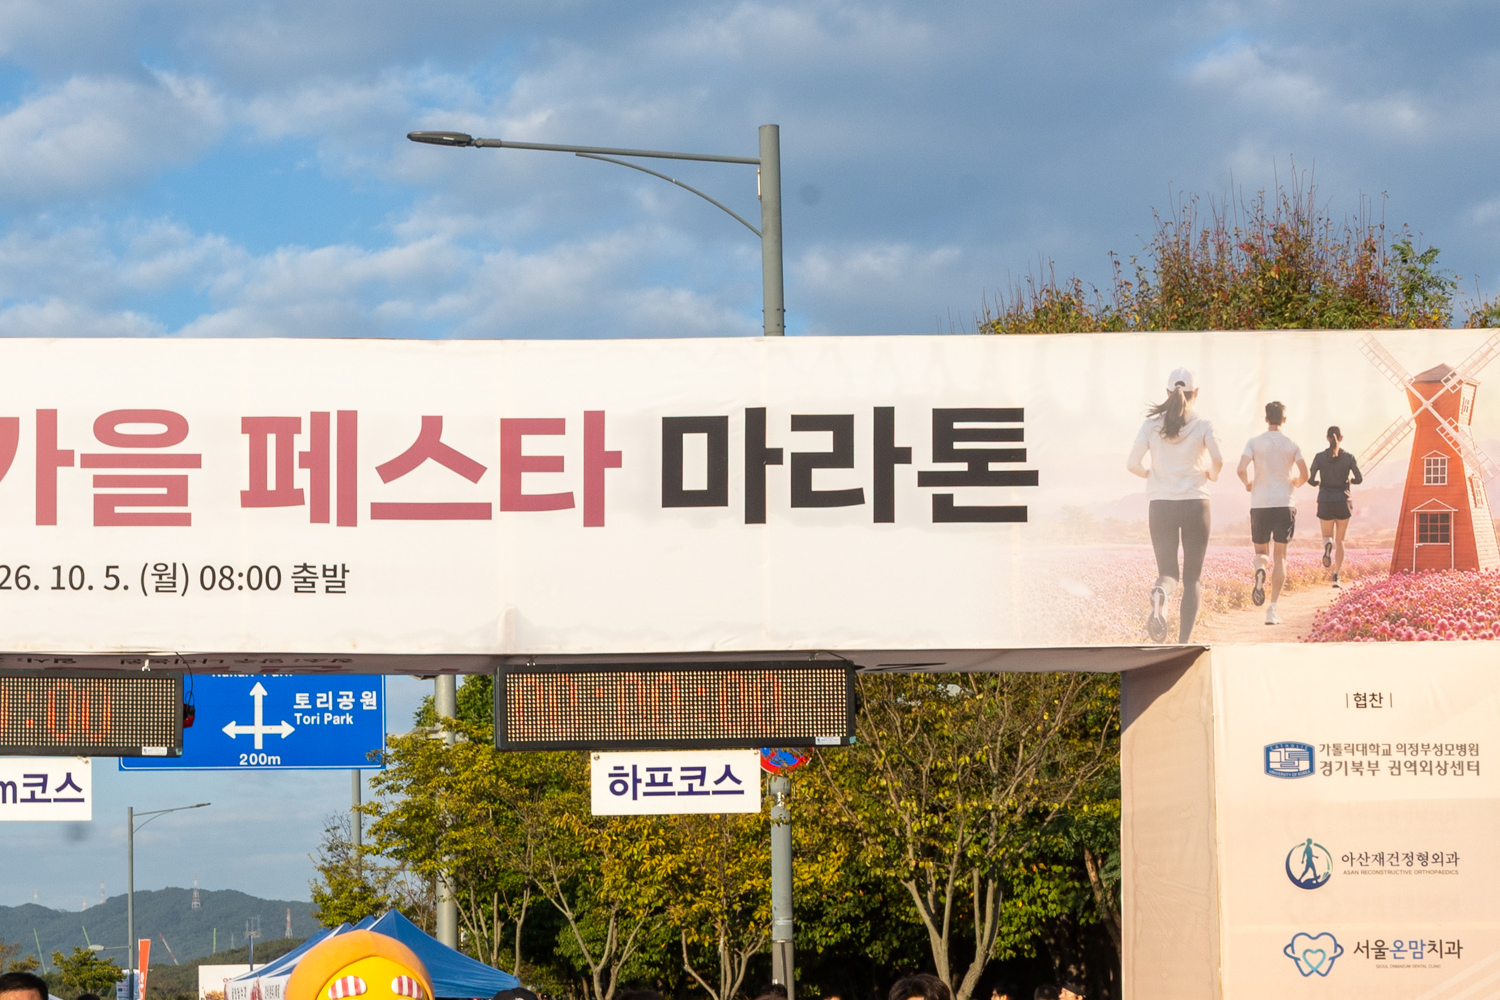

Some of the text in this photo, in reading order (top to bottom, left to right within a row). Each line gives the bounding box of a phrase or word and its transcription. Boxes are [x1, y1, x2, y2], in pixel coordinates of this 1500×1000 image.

[240, 409, 623, 528] 페스타
[661, 406, 1040, 525] 마라톤
[50, 565, 94, 591] 10.
[103, 565, 130, 591] 5.
[140, 562, 190, 597] (월)
[199, 564, 282, 591] 08:00
[290, 562, 350, 594] 출발
[293, 690, 378, 710] 토리공원
[1352, 692, 1384, 708] 협찬
[294, 712, 354, 725] Tori Park
[1318, 742, 1480, 757] 가톨릭대학교 의정부성모병원
[239, 752, 281, 765] 200m
[1319, 760, 1481, 777] 경기북부 권역외상센터
[608, 764, 745, 801] 하프코스
[1341, 851, 1460, 867] 아산재건정형외과
[1353, 939, 1464, 960] 서울온맘치과
